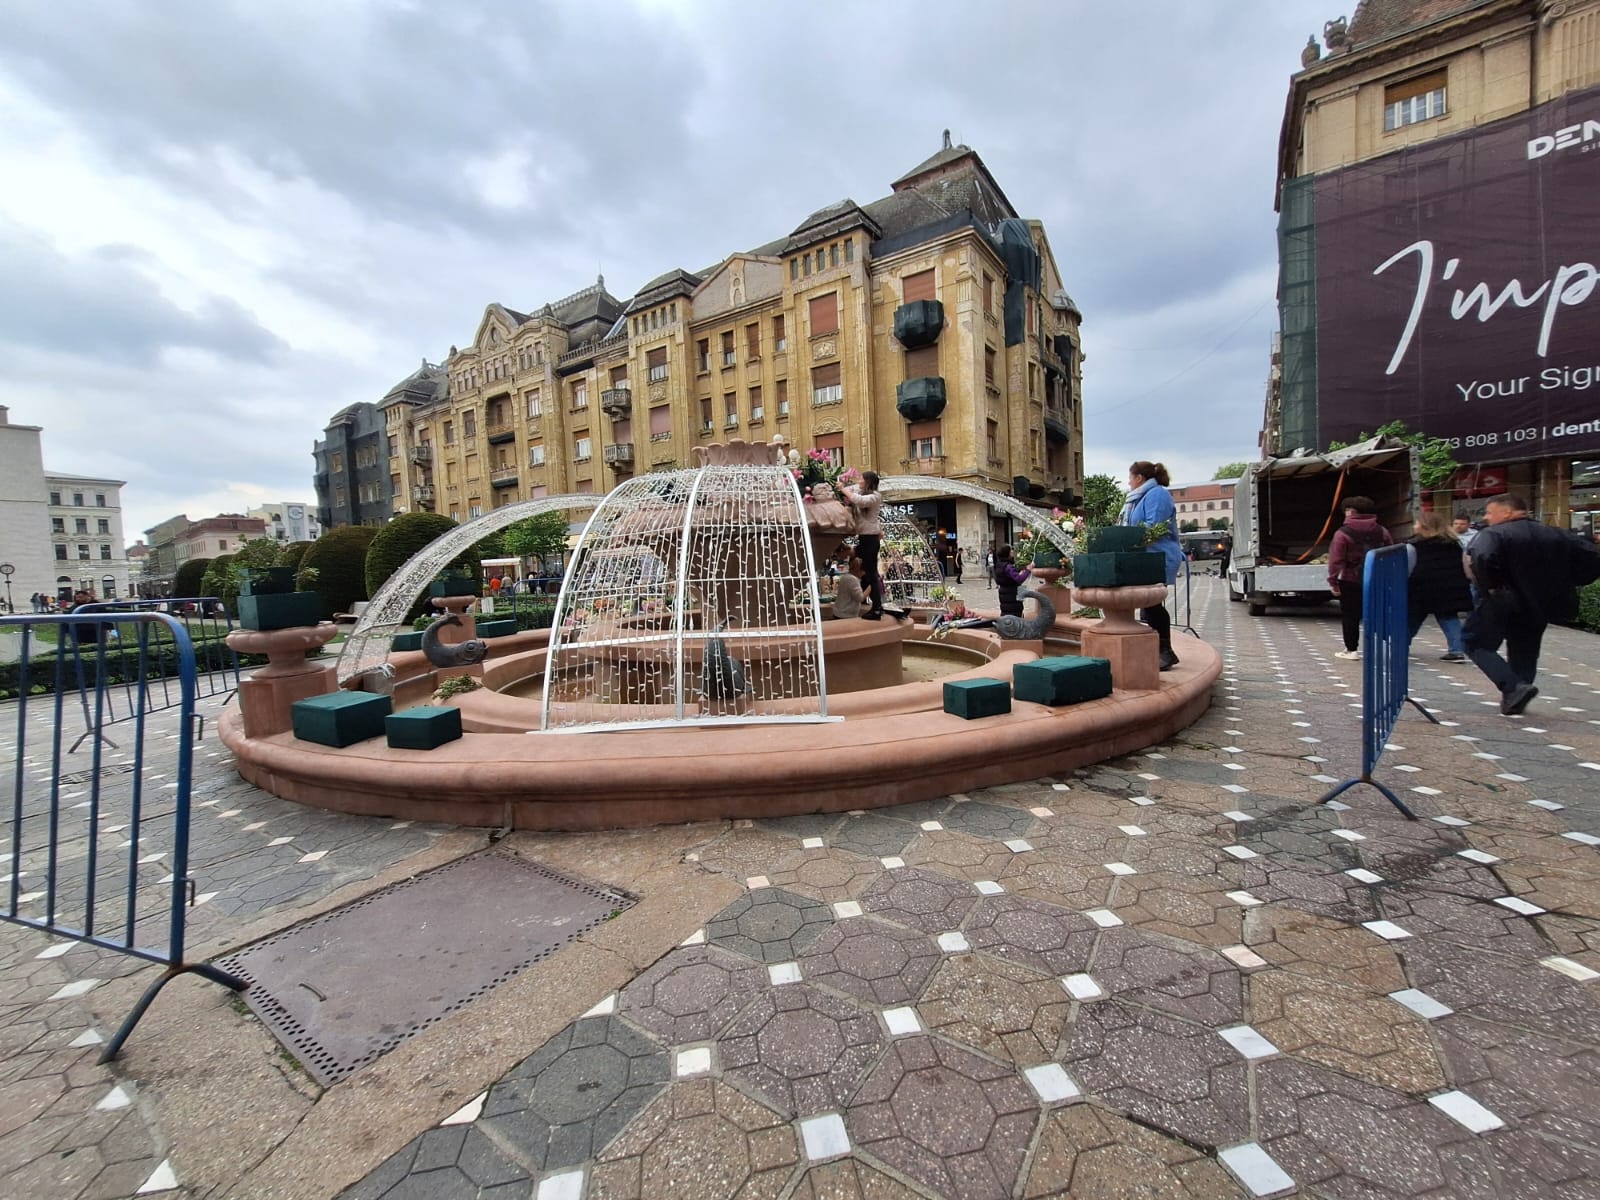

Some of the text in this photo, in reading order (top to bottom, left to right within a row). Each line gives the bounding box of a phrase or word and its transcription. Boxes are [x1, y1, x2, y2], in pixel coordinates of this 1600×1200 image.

[1456, 365, 1600, 402] Your Sig
[1465, 432, 1498, 447] 808
[1504, 427, 1537, 443] 103
[1551, 418, 1600, 437] dent
